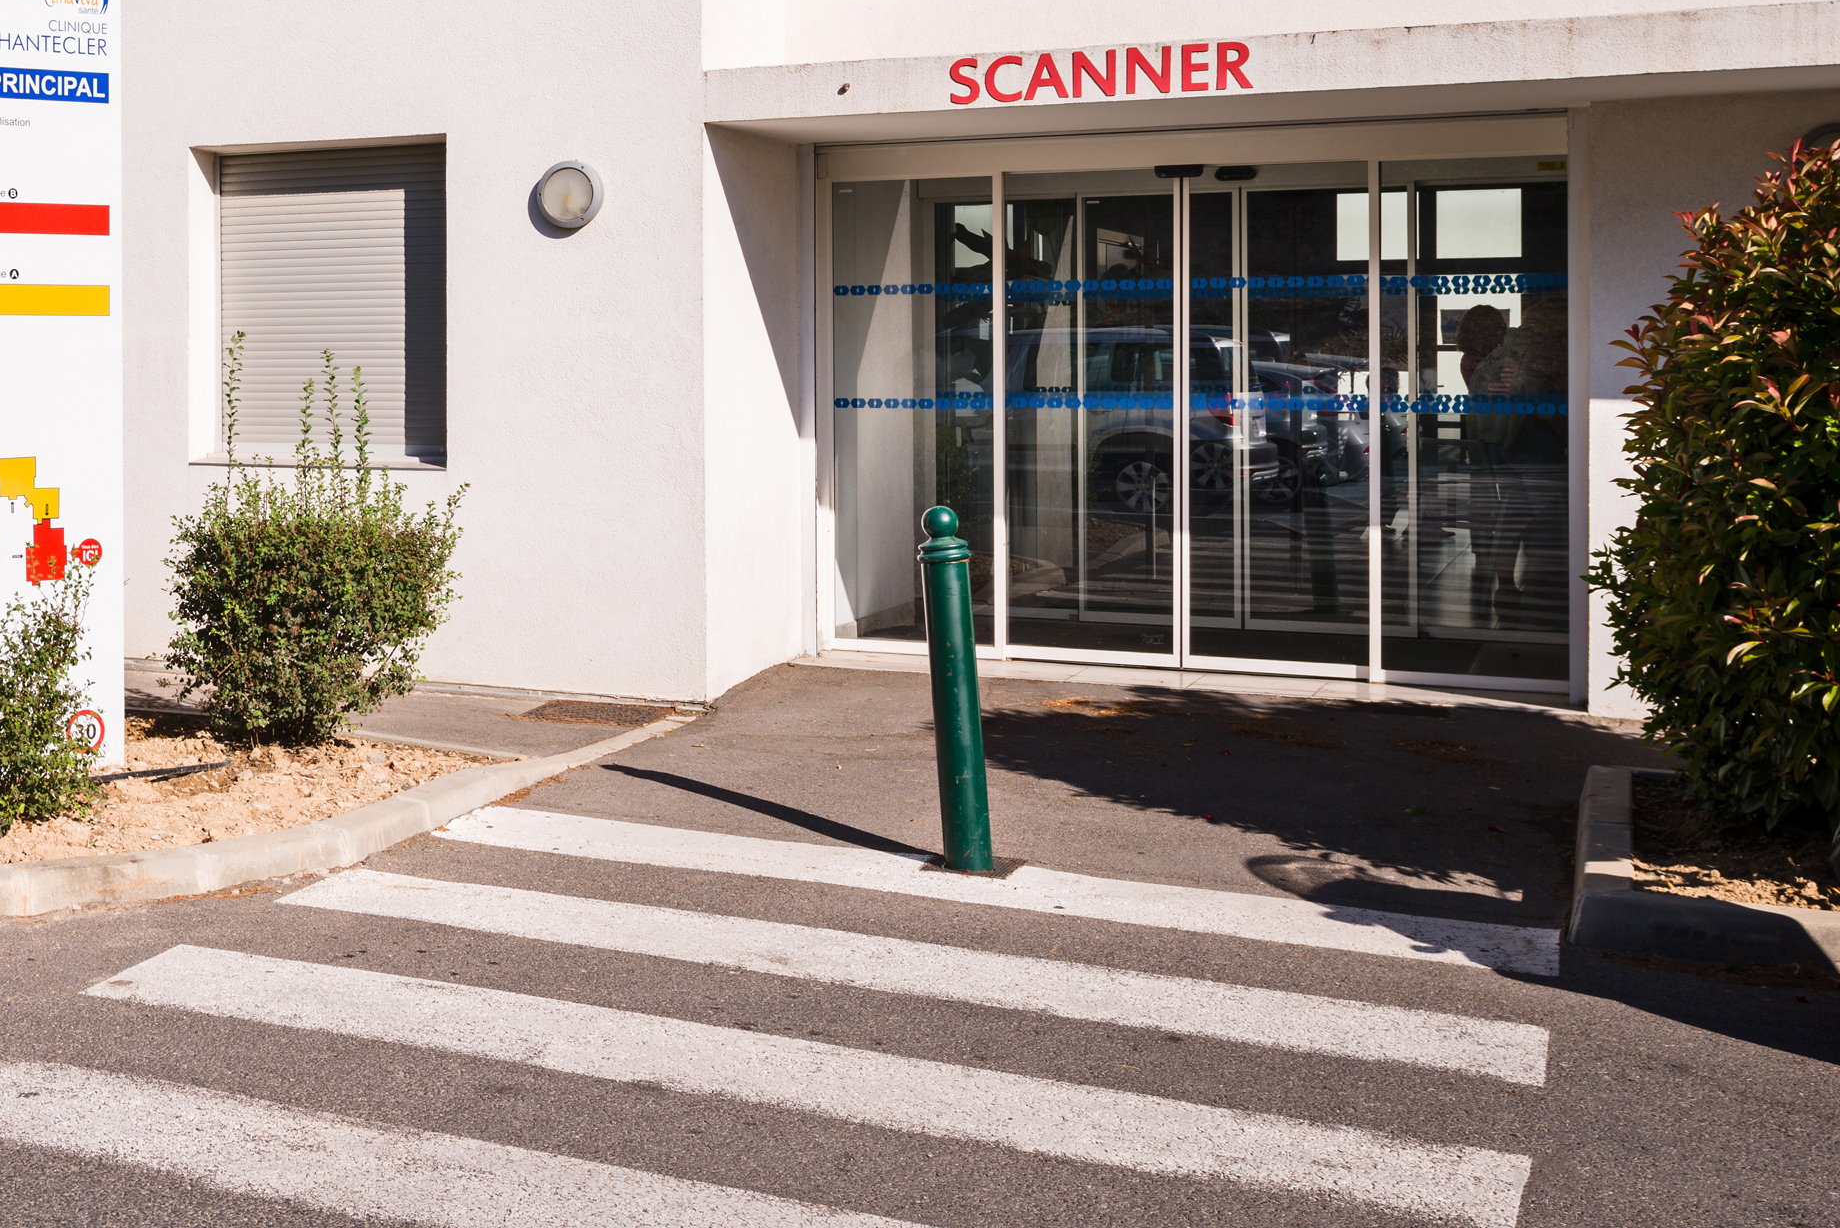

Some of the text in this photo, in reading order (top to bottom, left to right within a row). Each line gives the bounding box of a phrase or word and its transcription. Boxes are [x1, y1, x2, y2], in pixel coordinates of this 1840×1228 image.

[78, 6, 98, 15] santé
[49, 20, 107, 34] CLINIQUE
[950, 42, 1253, 104] SCANNER
